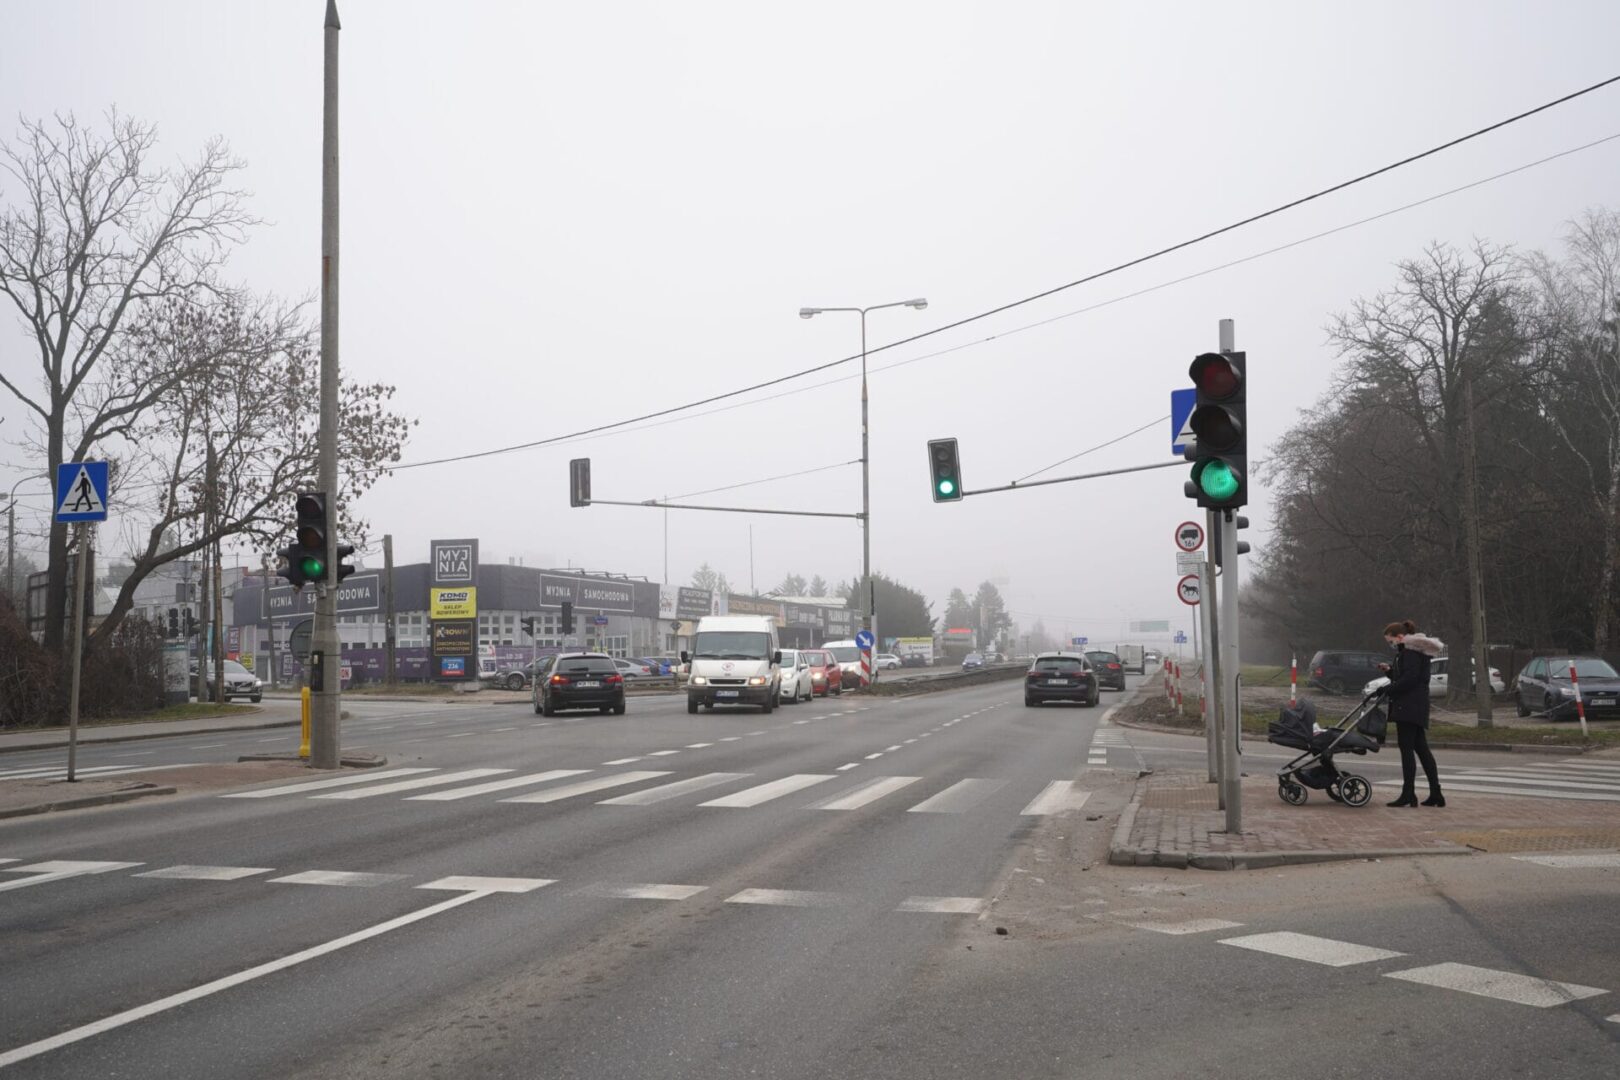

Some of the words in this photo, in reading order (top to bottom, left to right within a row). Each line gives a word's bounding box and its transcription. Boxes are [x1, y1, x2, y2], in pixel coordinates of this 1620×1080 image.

[439, 549, 469, 561] MYJ
[439, 561, 468, 573] NIA
[546, 585, 571, 598] MYJNIA
[584, 588, 629, 602] SAMOCHODOWA
